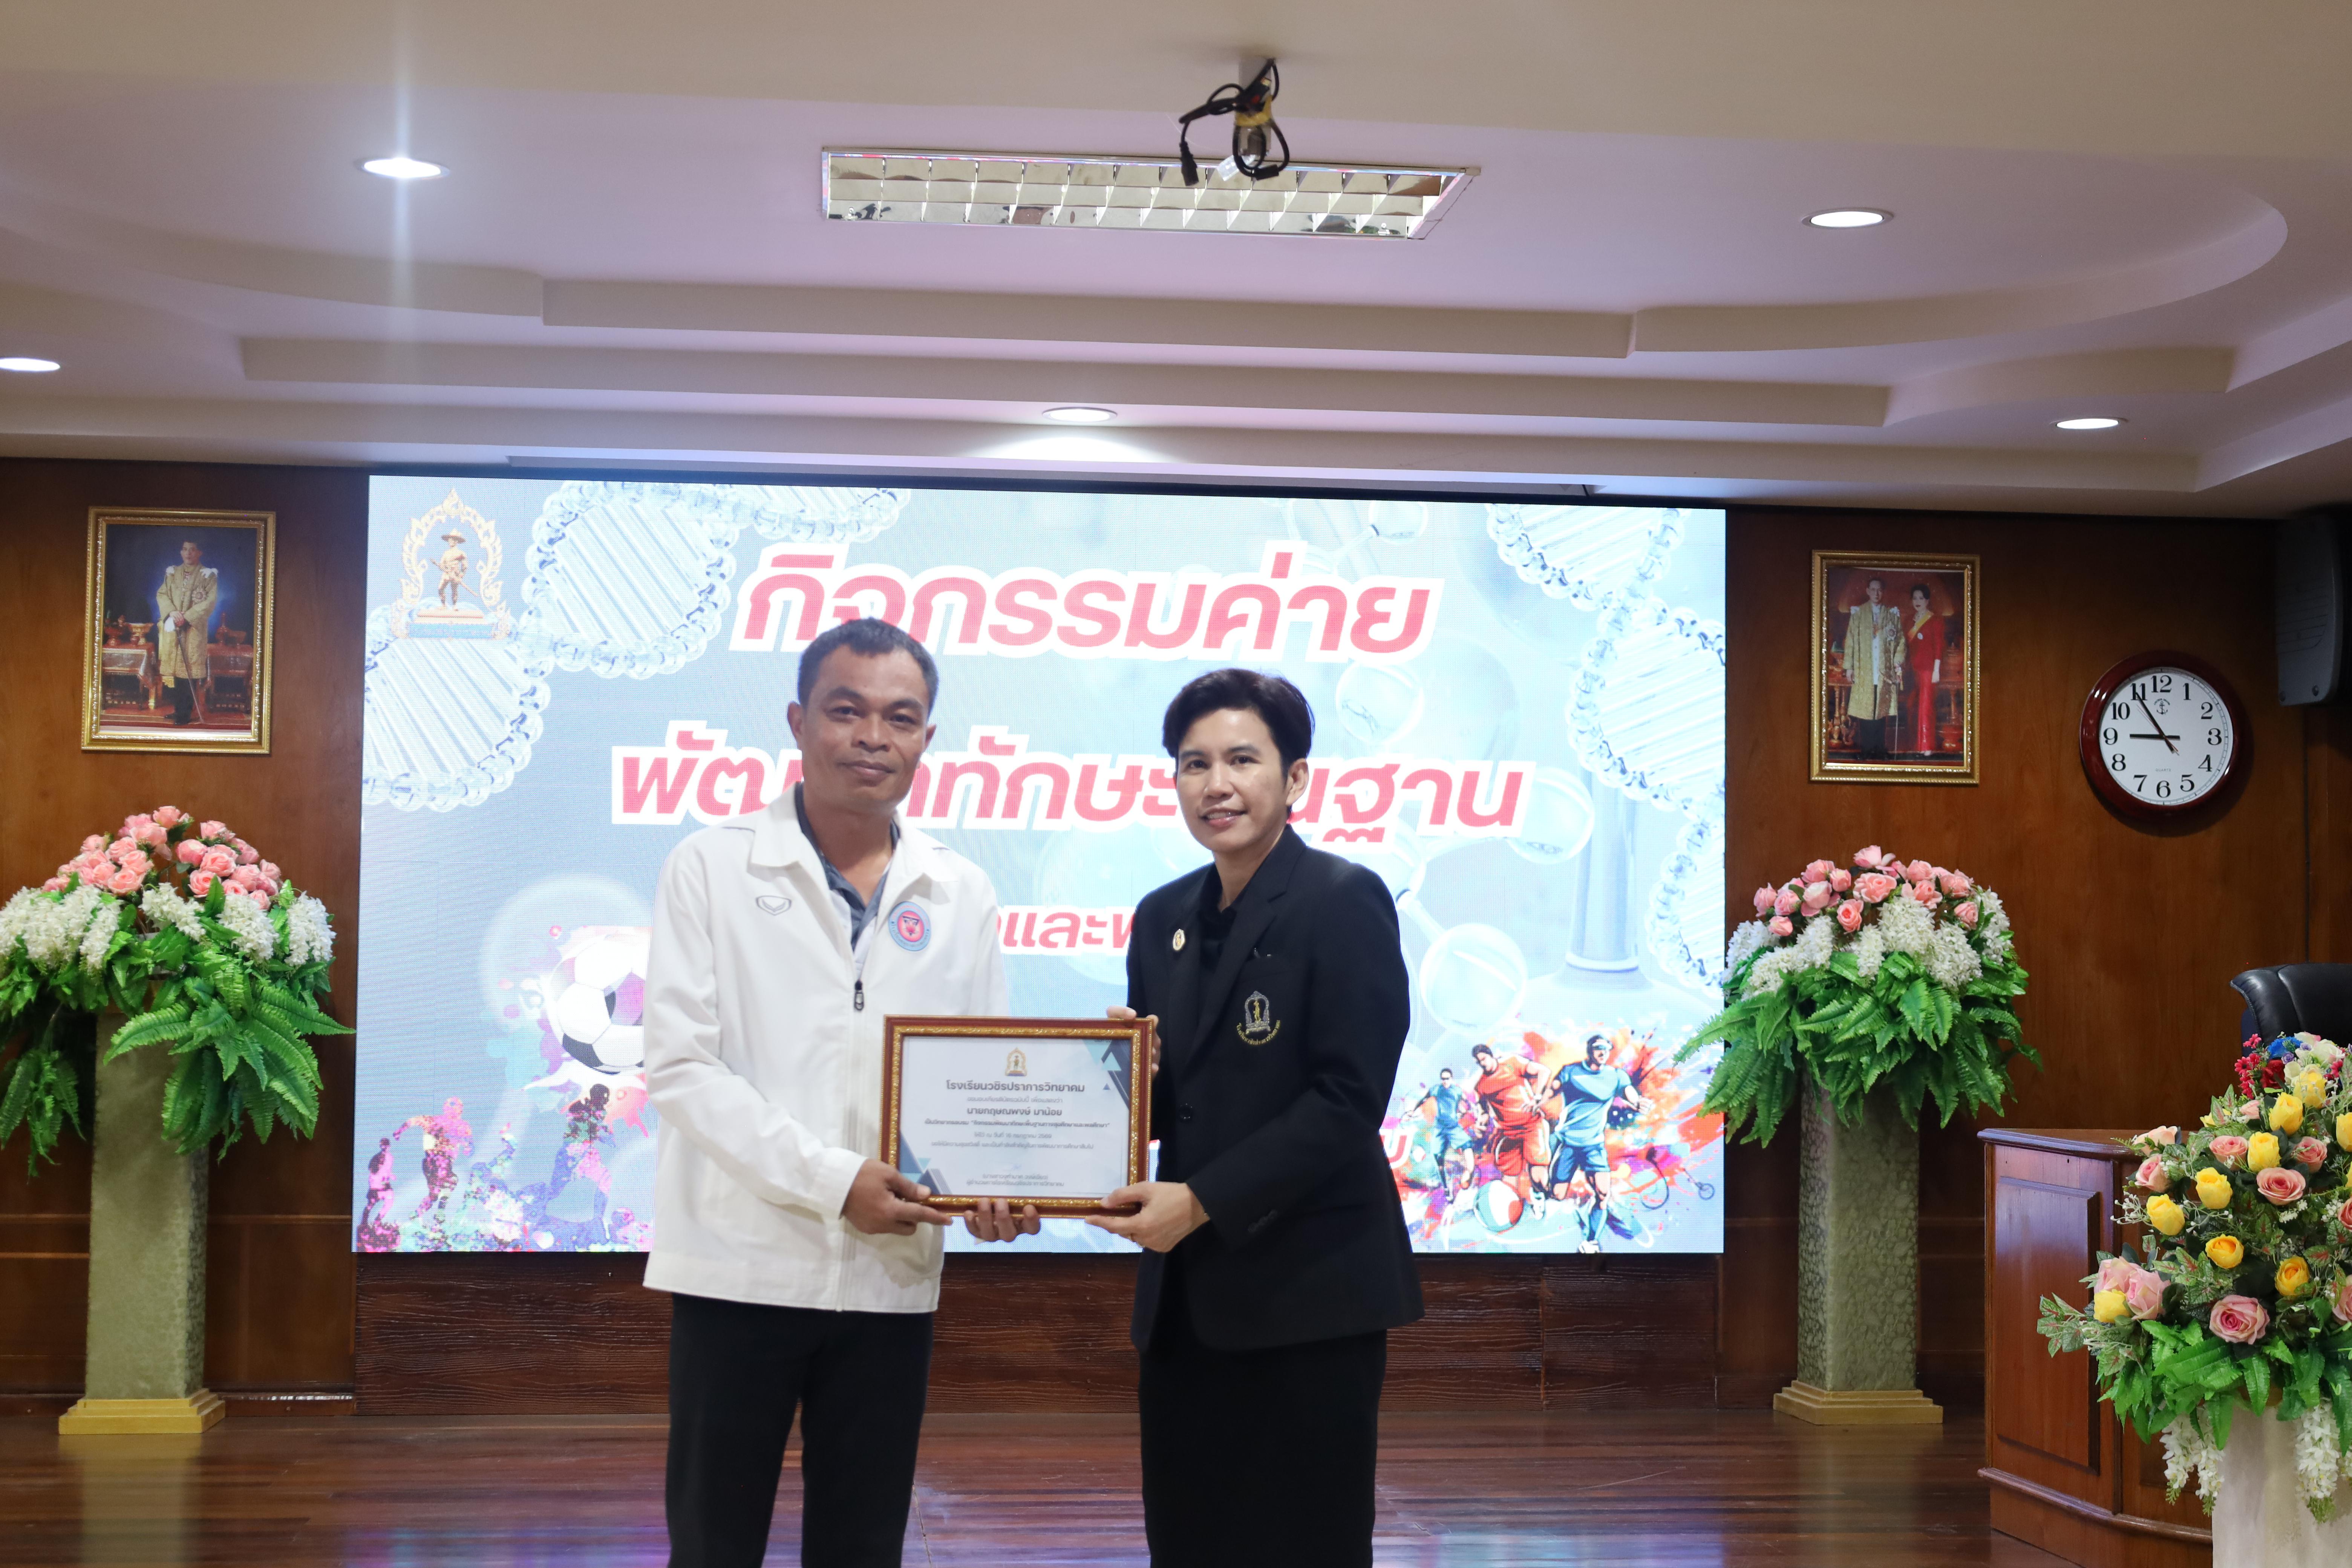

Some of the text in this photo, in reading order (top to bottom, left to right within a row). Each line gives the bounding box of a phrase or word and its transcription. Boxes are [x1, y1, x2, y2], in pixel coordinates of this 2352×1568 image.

[744, 552, 1430, 653] กิจกรรมค่าย
[2130, 683, 2147, 700] 11
[2151, 675, 2171, 693] 12
[2183, 683, 2191, 700] 1
[2112, 702, 2130, 720] 10
[2201, 702, 2213, 719] 2
[2103, 727, 2118, 745] 9
[2207, 728, 2222, 745] 3
[2112, 753, 2126, 771] 8
[2198, 754, 2213, 772] 4
[2133, 774, 2147, 792] 7
[2156, 781, 2171, 798] 6
[2180, 774, 2194, 792] 5
[946, 1079, 1085, 1092] โรงเรียนวชิรปราการวิทยาคม
[1034, 1106, 1062, 1116] มาน้อย
